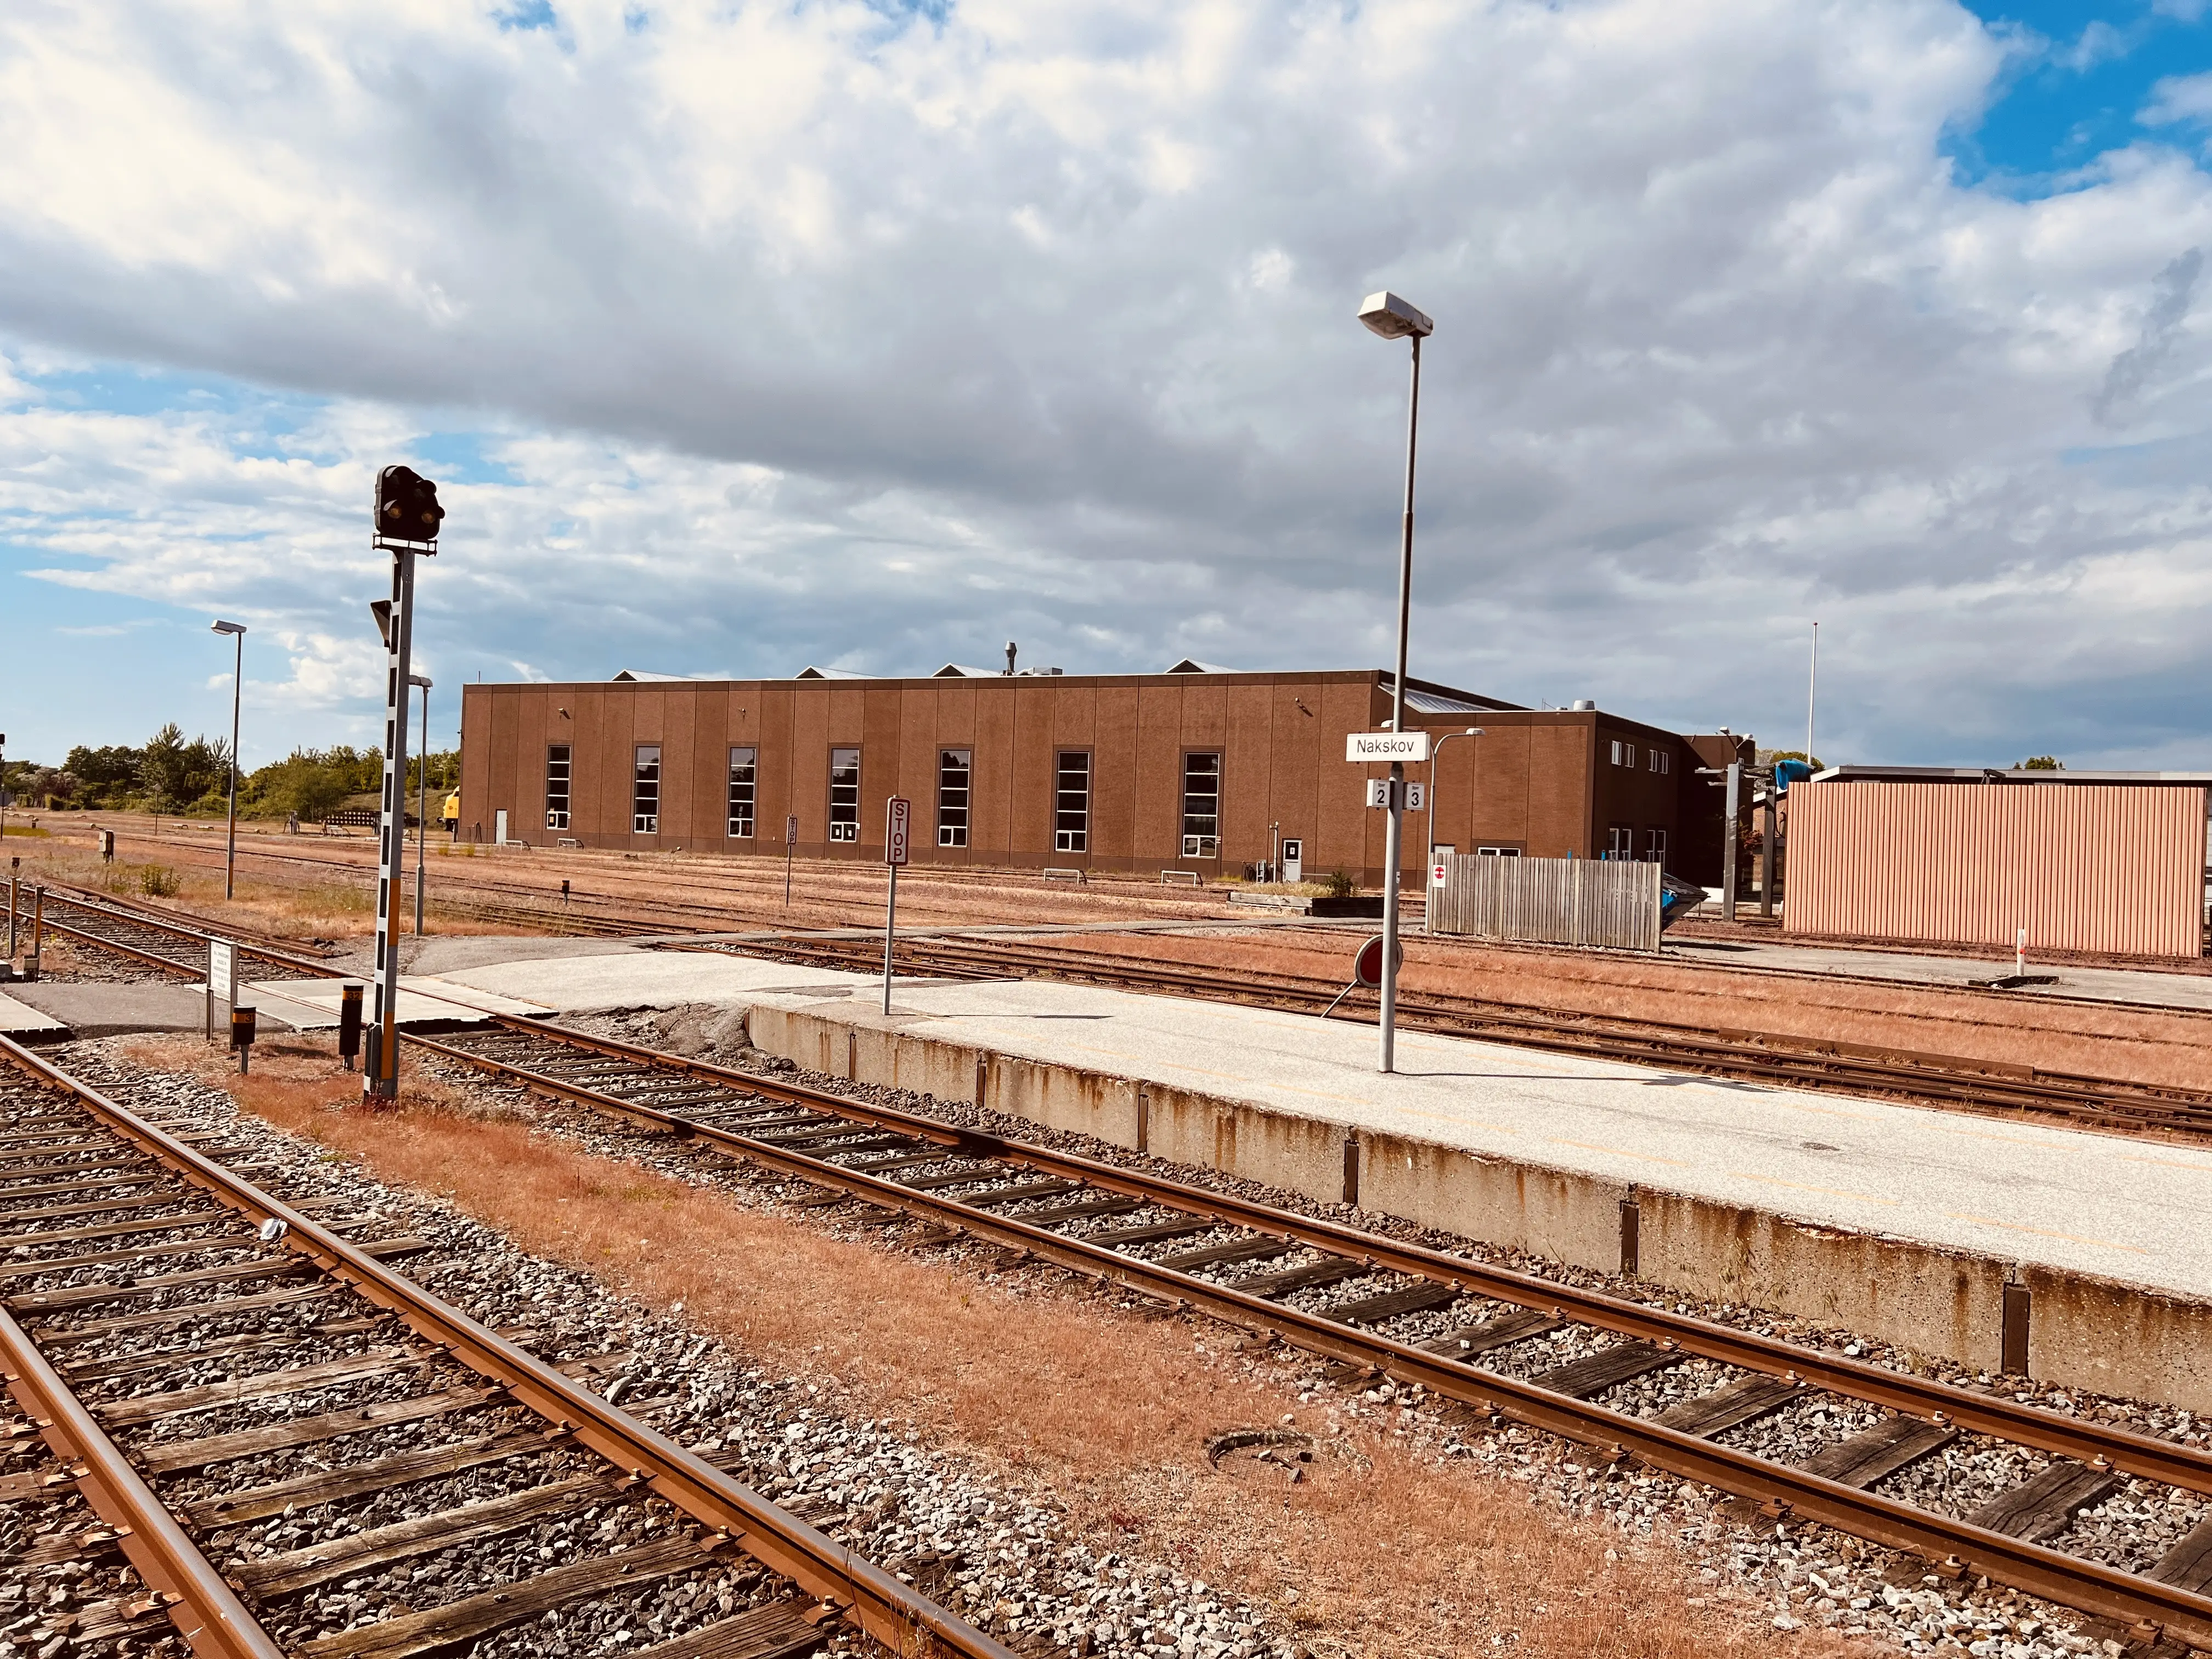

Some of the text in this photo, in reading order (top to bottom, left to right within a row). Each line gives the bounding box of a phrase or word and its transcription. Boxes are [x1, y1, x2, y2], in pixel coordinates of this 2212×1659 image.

[1357, 738, 1414, 753] Nakskov
[1378, 789, 1385, 804] 2
[1412, 792, 1419, 806] 3
[894, 803, 905, 861] STOP
